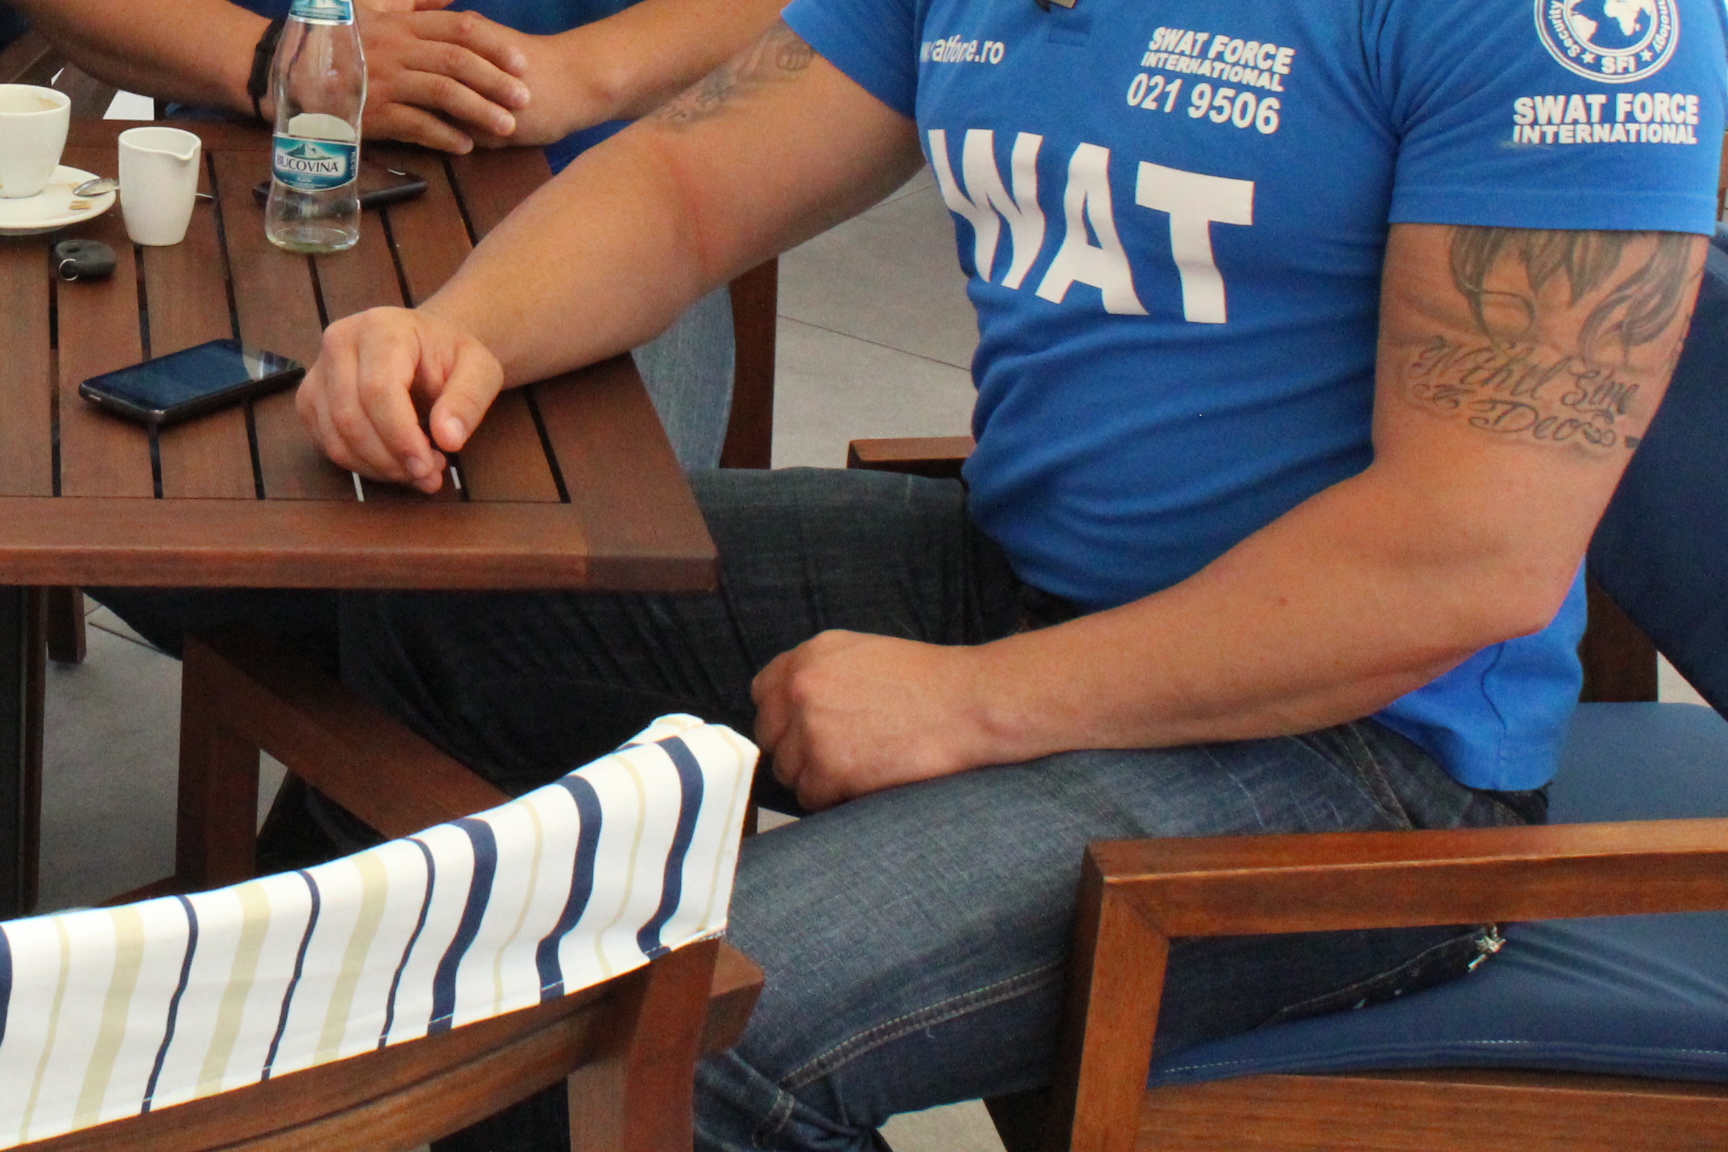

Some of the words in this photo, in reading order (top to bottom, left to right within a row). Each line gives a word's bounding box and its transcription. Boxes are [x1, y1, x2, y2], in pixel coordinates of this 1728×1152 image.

[1548, 0, 1583, 57] Security
[1148, 26, 1211, 57] SWAT
[1207, 34, 1297, 75] FORCE
[1601, 56, 1638, 74] SFI
[1140, 51, 1286, 93] INTERNATIONAL
[1126, 72, 1184, 114] 021
[1187, 82, 1282, 135] 9506
[1513, 94, 1608, 125] SWAT
[1616, 92, 1700, 125] FORCE
[1512, 122, 1699, 145] INTERNATIONAL
[276, 155, 339, 173] BUCOVINA
[927, 128, 1255, 325] WAT
